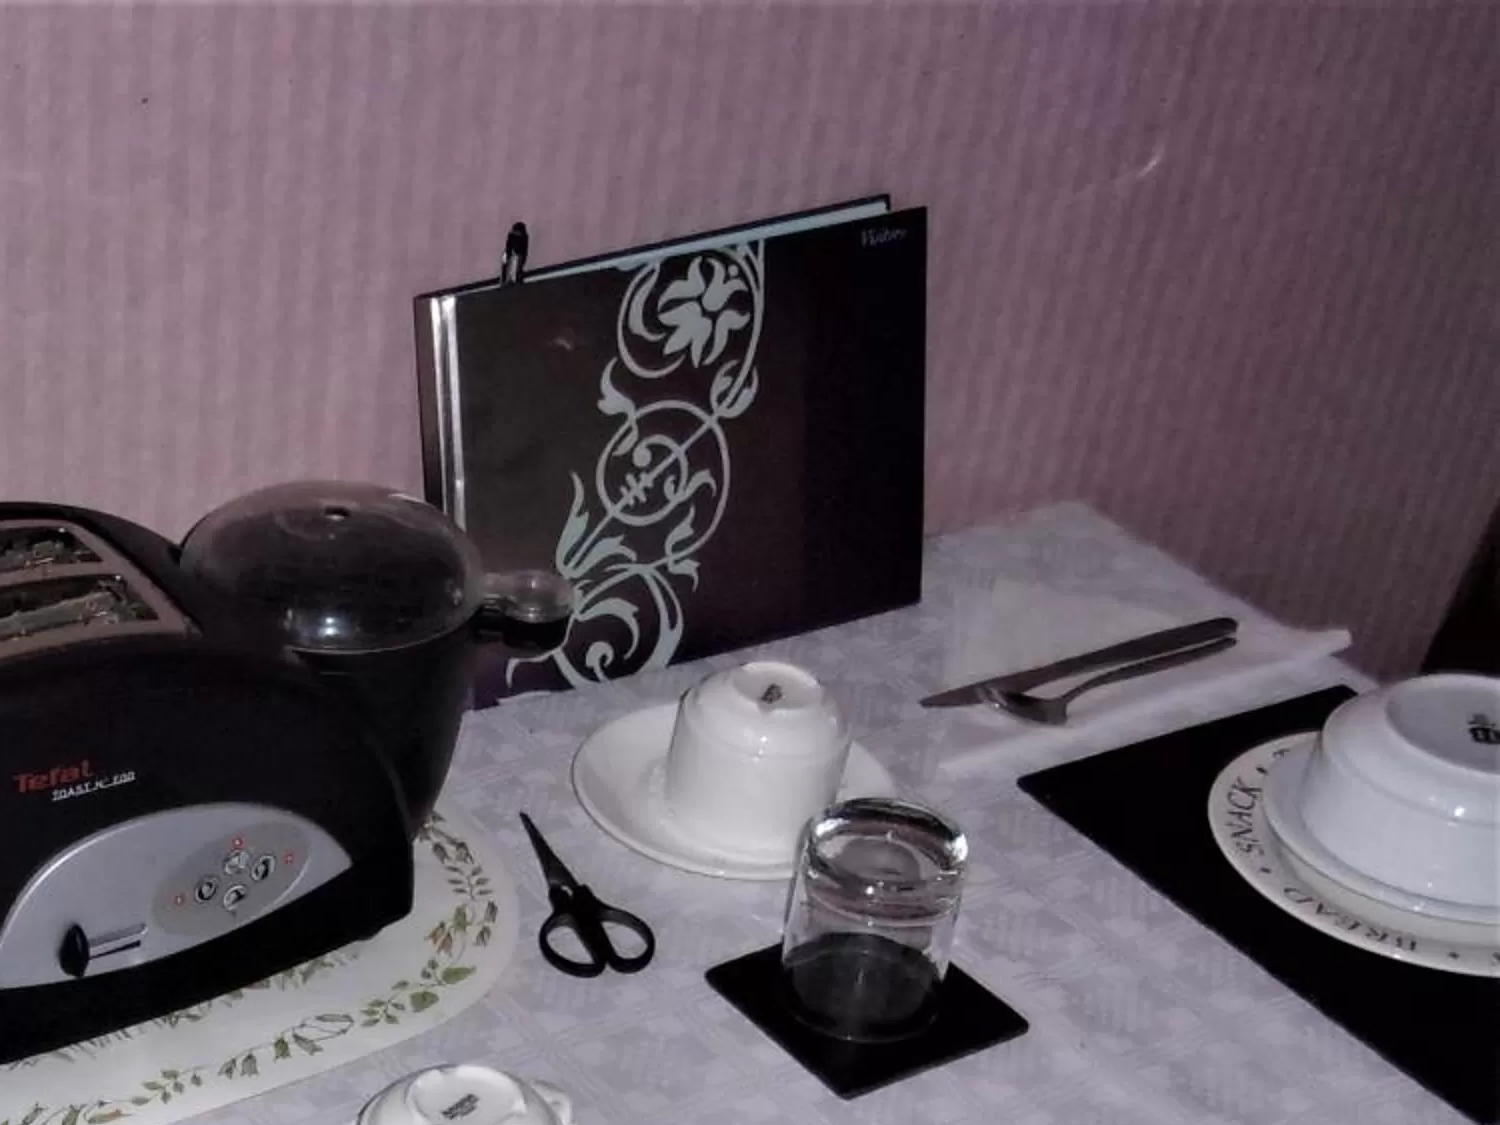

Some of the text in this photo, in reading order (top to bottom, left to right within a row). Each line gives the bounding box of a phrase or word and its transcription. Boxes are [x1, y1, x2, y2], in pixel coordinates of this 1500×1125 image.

[13, 760, 92, 792] Tefal
[51, 782, 91, 801] TOAST
[1225, 776, 1264, 856] SNACK
